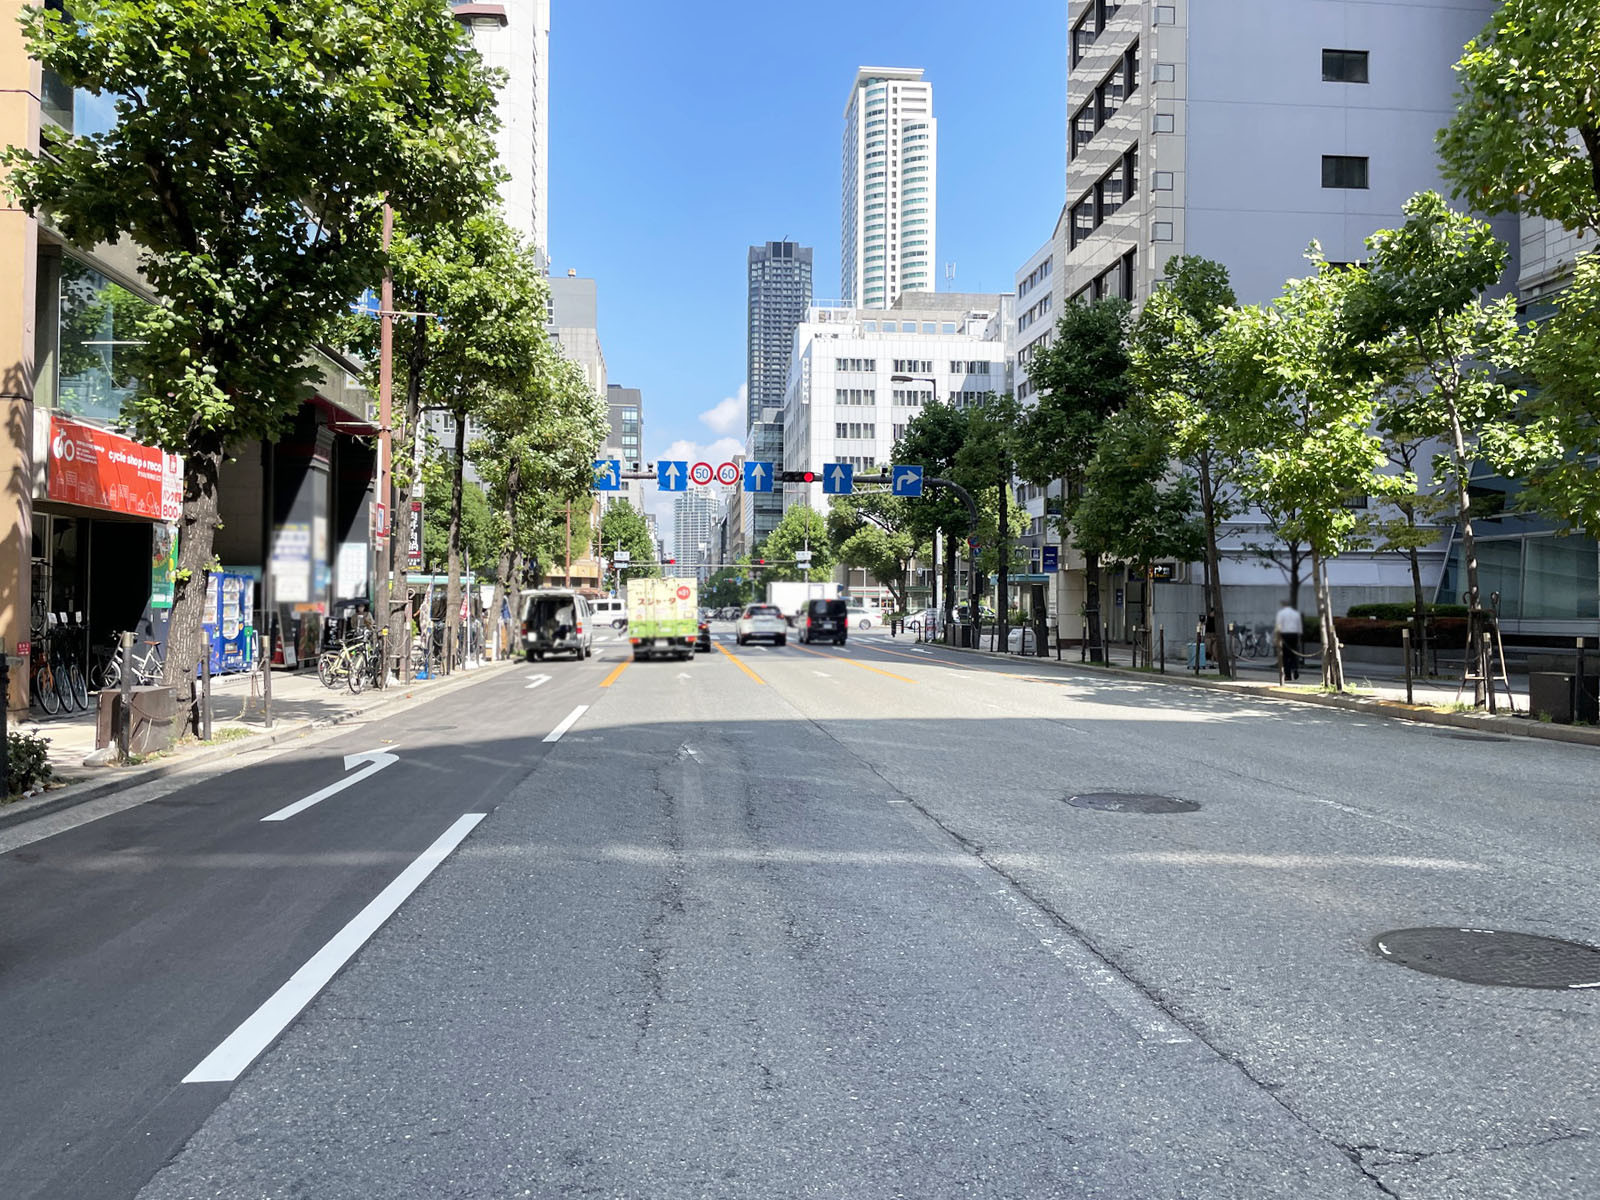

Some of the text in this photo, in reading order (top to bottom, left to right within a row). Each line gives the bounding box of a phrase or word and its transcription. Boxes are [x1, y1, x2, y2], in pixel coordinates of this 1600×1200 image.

[109, 451, 126, 463] cycle
[127, 455, 142, 469] shop
[695, 468, 709, 480] 50
[721, 468, 735, 480] 60
